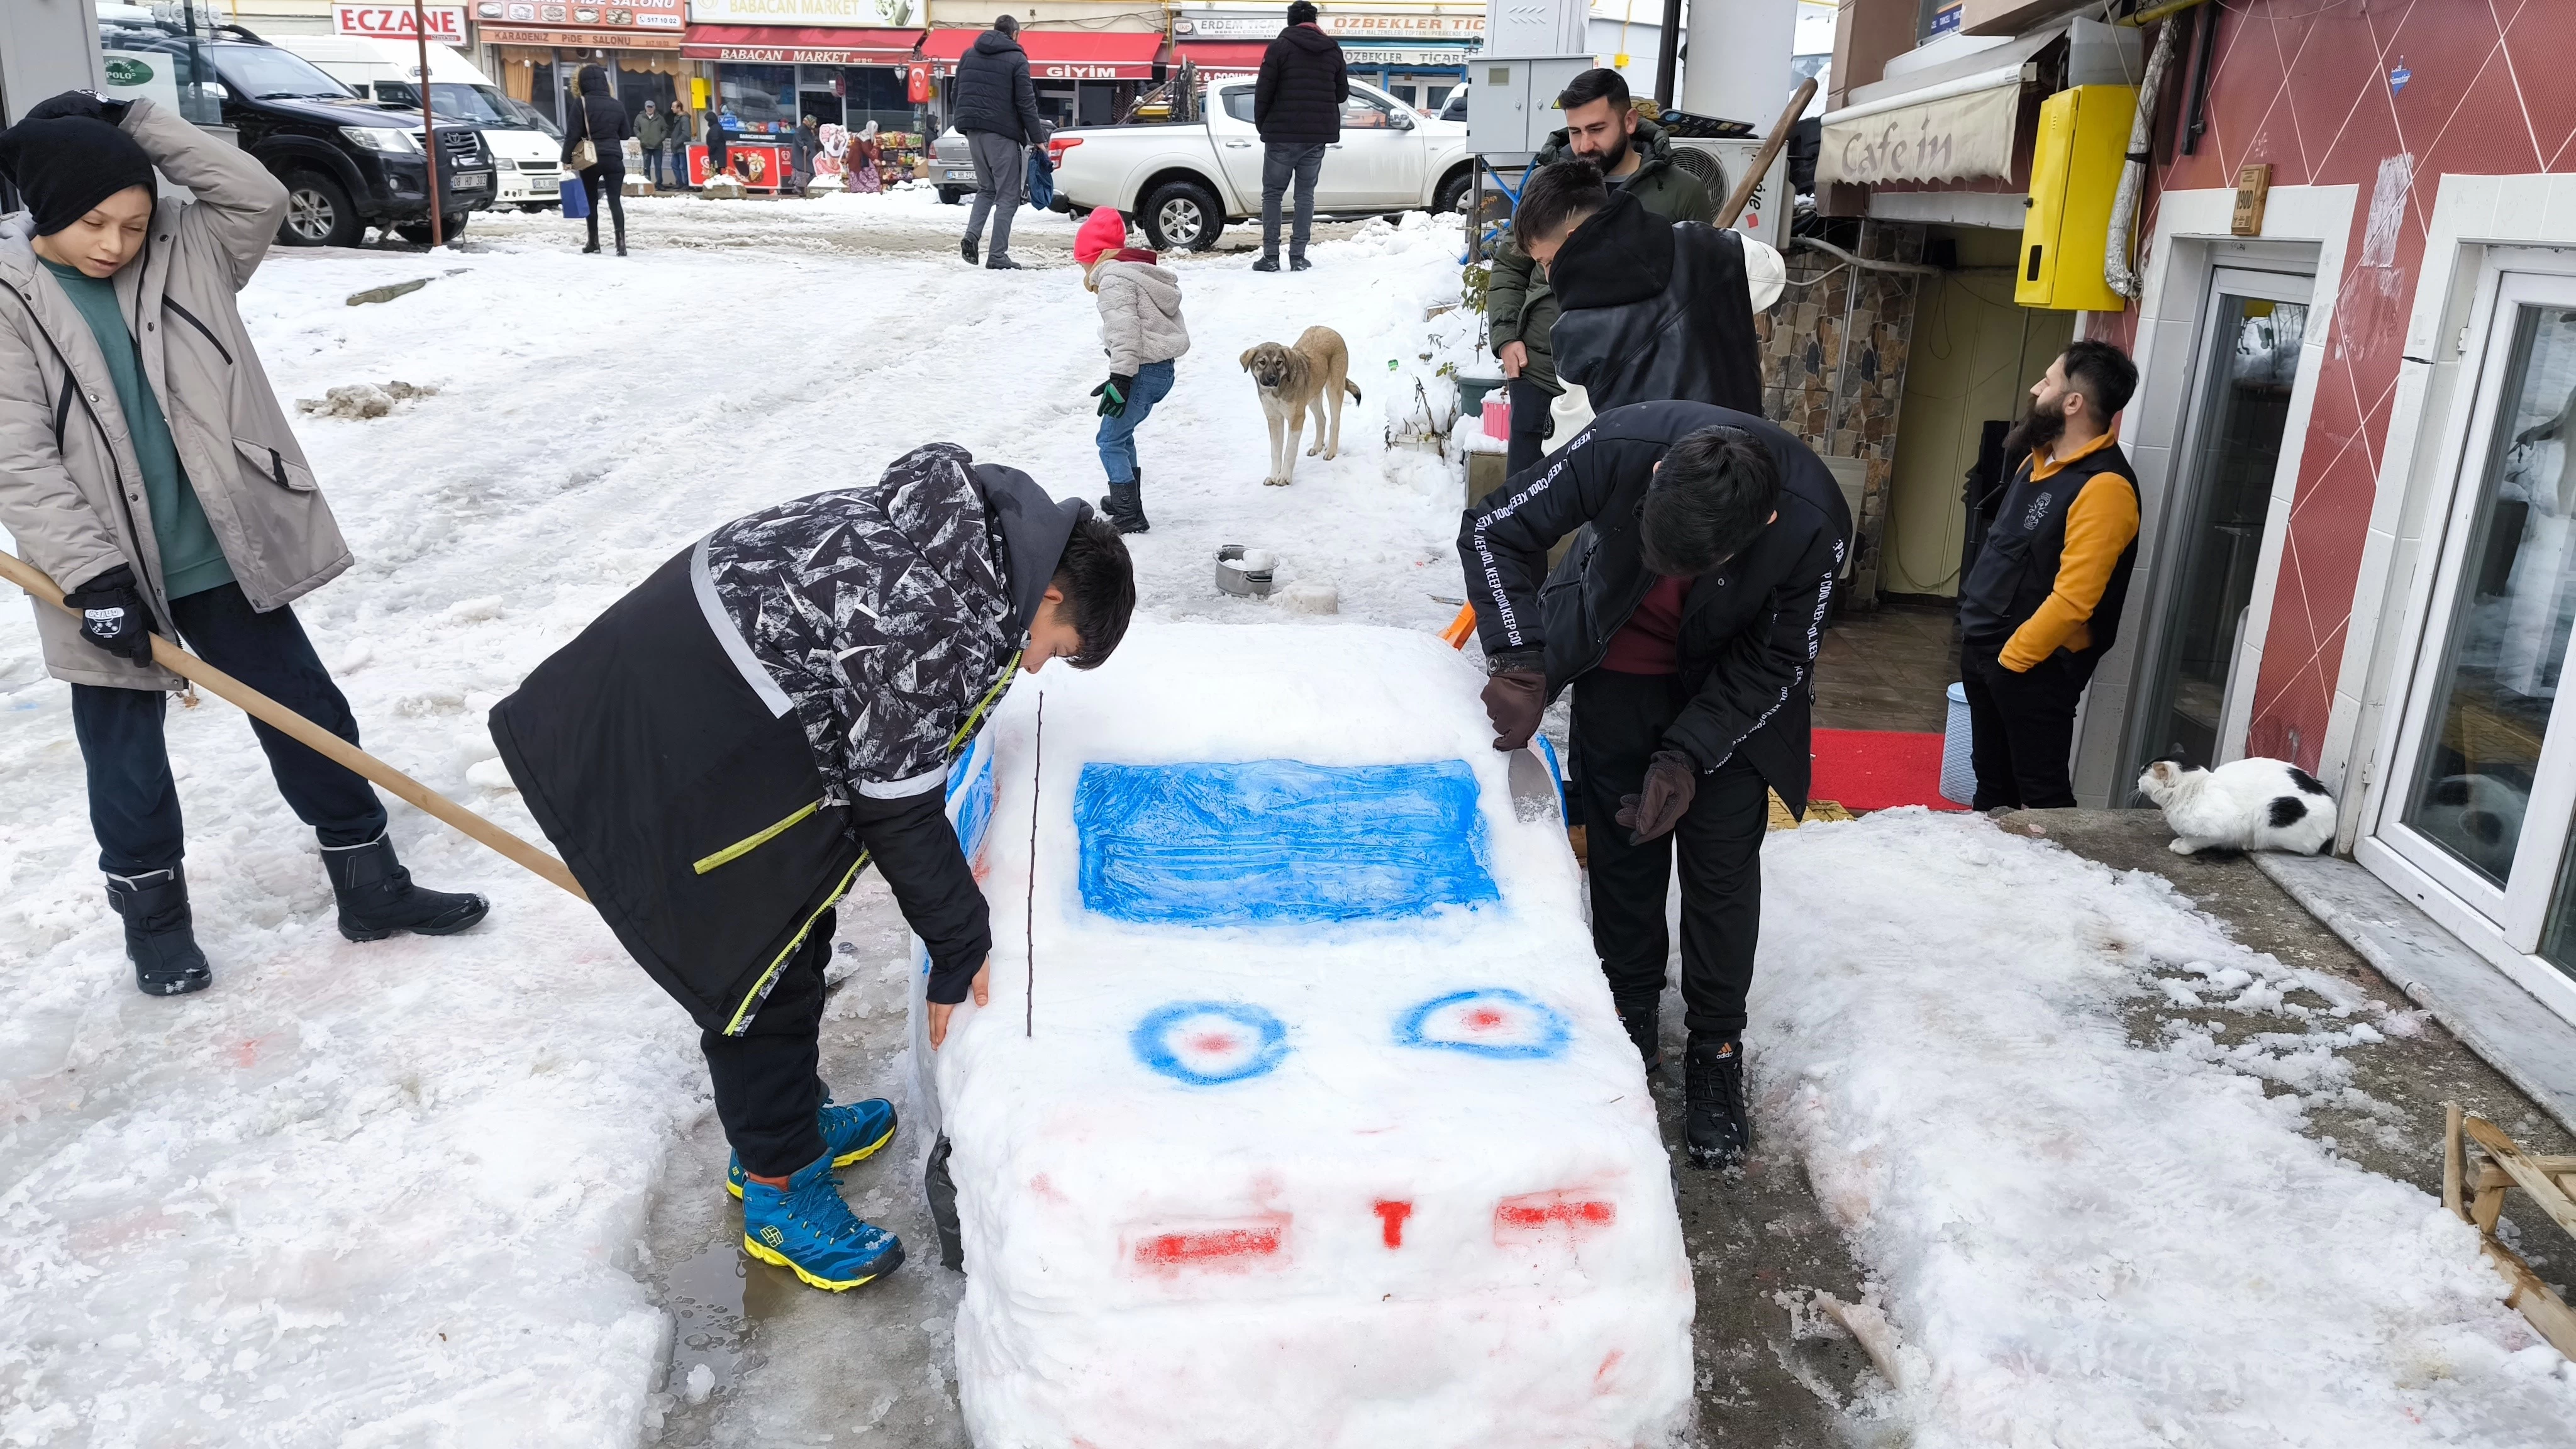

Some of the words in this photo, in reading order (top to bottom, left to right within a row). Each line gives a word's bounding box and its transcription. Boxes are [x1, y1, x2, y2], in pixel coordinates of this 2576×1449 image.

[730, 0, 796, 13] BABACAN
[801, 0, 859, 14] MARKET
[341, 9, 457, 32] ECZANE
[1201, 21, 1243, 29] ERDEM
[592, 36, 631, 45] SALONU
[720, 49, 784, 60] BABACAN
[792, 50, 850, 62] MARKET
[1419, 52, 1467, 63] TİCARE
[106, 71, 132, 79] POLO
[1046, 65, 1116, 77] GİYİM
[1841, 121, 1907, 177] Cafe
[453, 177, 460, 186] 08
[1528, 477, 1549, 497] COOL
[1474, 535, 1486, 551] KEE
[1485, 567, 1501, 589] KEEP
[1818, 580, 1833, 603] COOL
[1500, 607, 1517, 630] KEEP
[1716, 1051, 1734, 1060] adida
